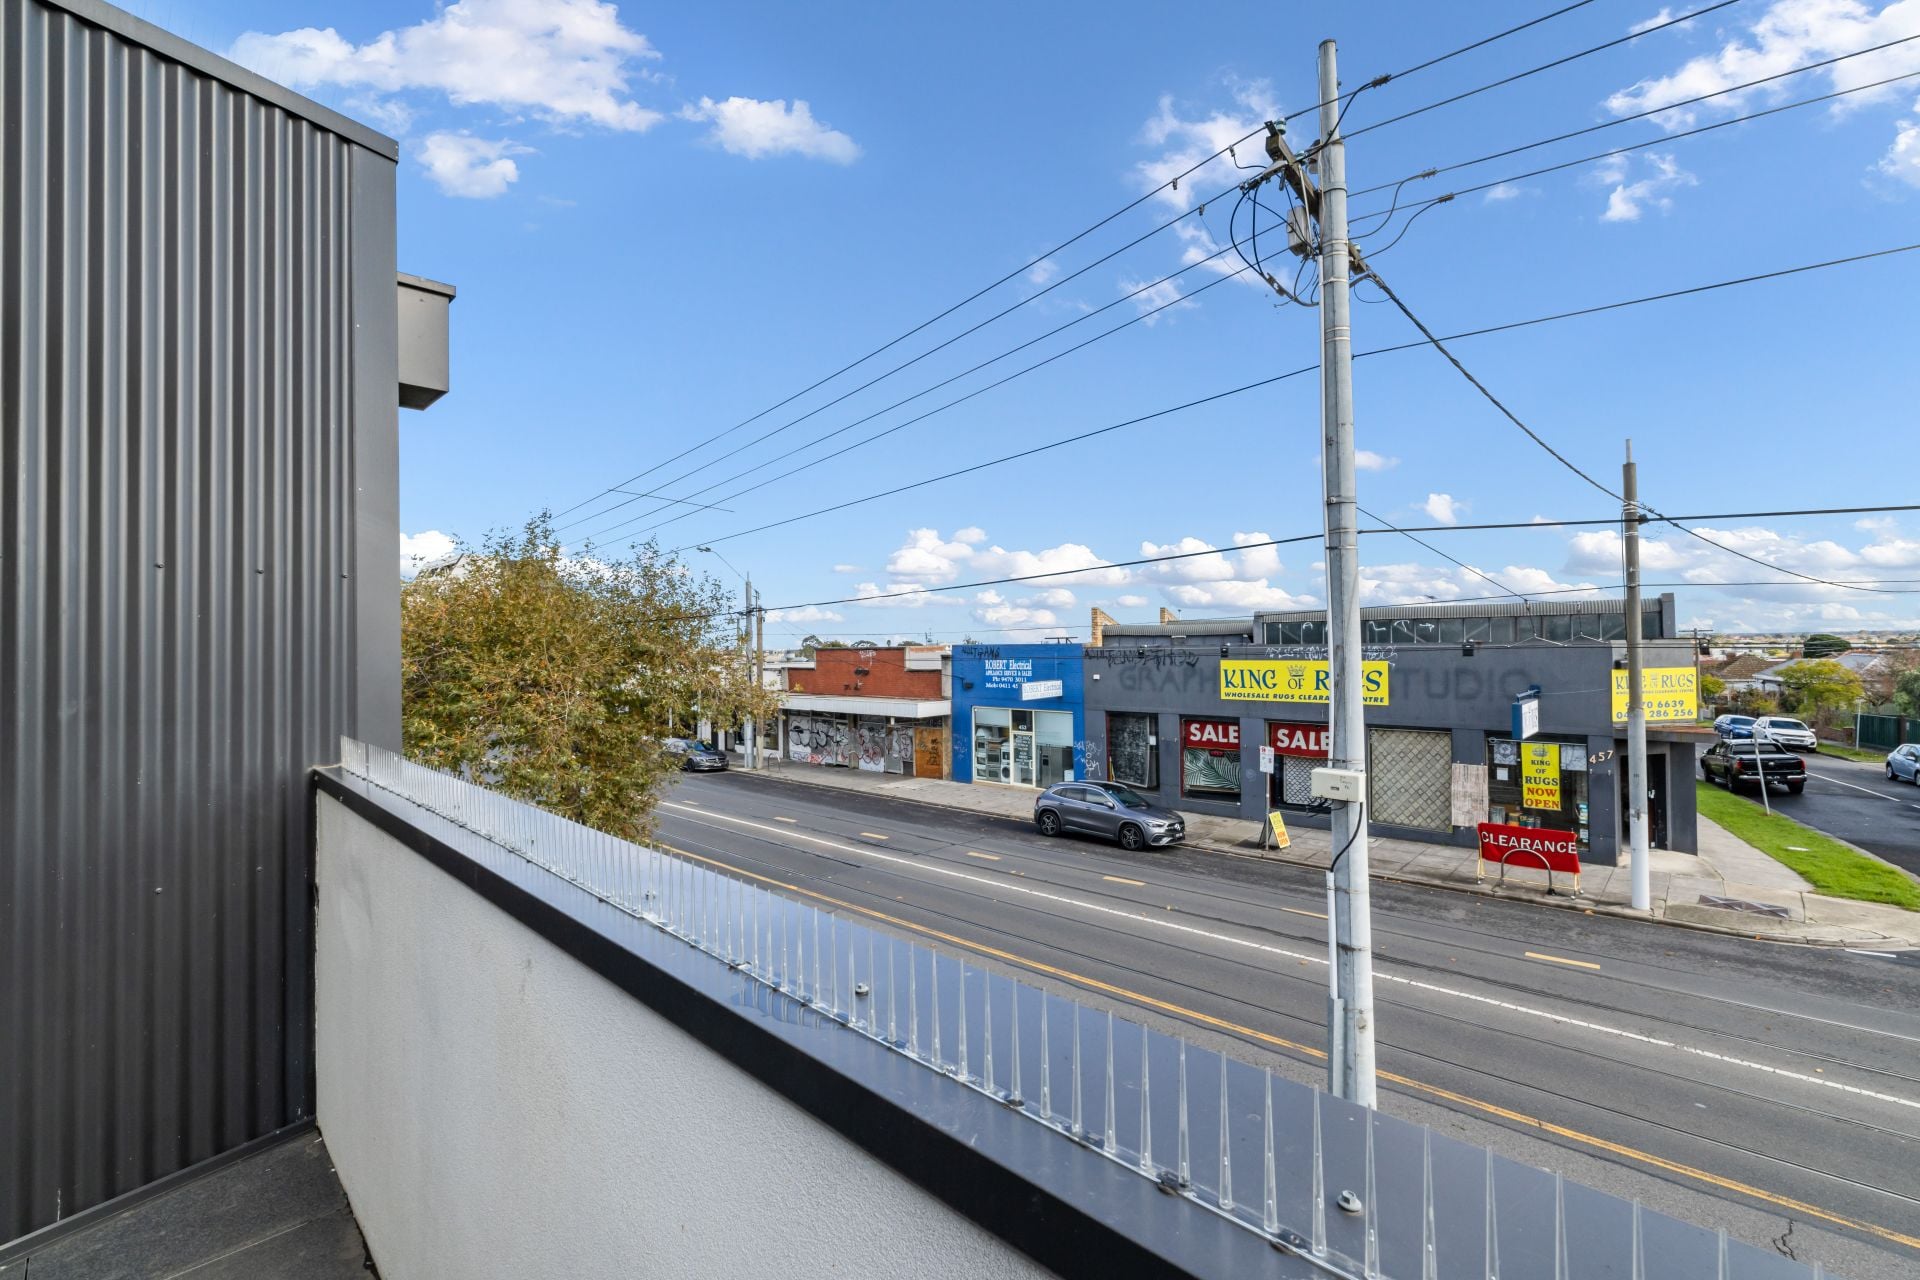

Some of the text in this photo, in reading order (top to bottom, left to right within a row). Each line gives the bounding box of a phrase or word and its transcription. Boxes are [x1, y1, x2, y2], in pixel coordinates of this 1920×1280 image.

[985, 659, 1032, 670] ROBERT Electrical
[1119, 665, 1218, 693] GRAPH
[1223, 669, 1383, 693] KING OF RS
[1661, 674, 1694, 688] RUGS
[1657, 700, 1684, 708] 6639
[1190, 723, 1239, 744] SALE
[1276, 728, 1329, 751] SALE
[1589, 750, 1614, 764] 457
[1525, 775, 1559, 786] RUGS
[1526, 787, 1558, 797] NOW
[1525, 798, 1560, 809] OPEN
[1481, 831, 1577, 854] CLEARANCE
